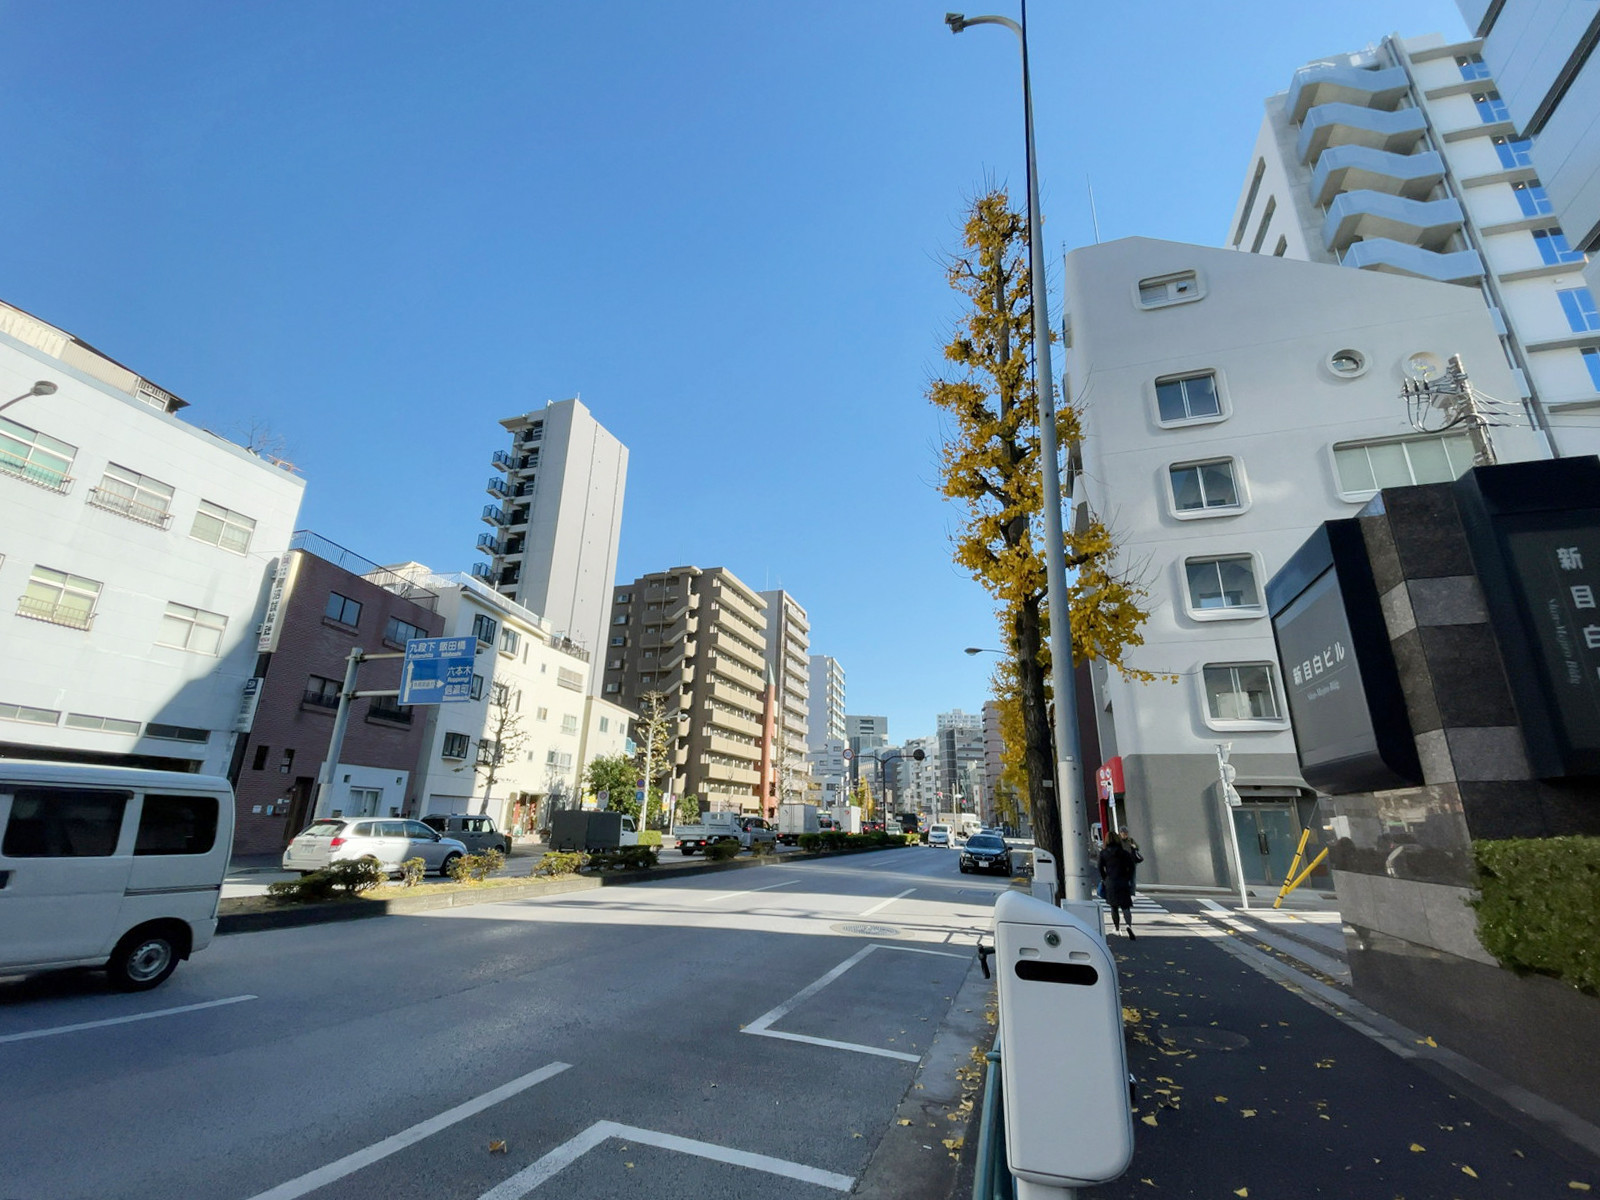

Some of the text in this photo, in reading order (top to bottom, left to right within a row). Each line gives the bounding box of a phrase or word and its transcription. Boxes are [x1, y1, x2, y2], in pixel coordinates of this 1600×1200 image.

[1556, 547, 1600, 681] 新目白
[409, 641, 466, 653] 九段下 飯田橋
[447, 666, 472, 676] 六本木
[1292, 641, 1345, 686] 新目白ビル
